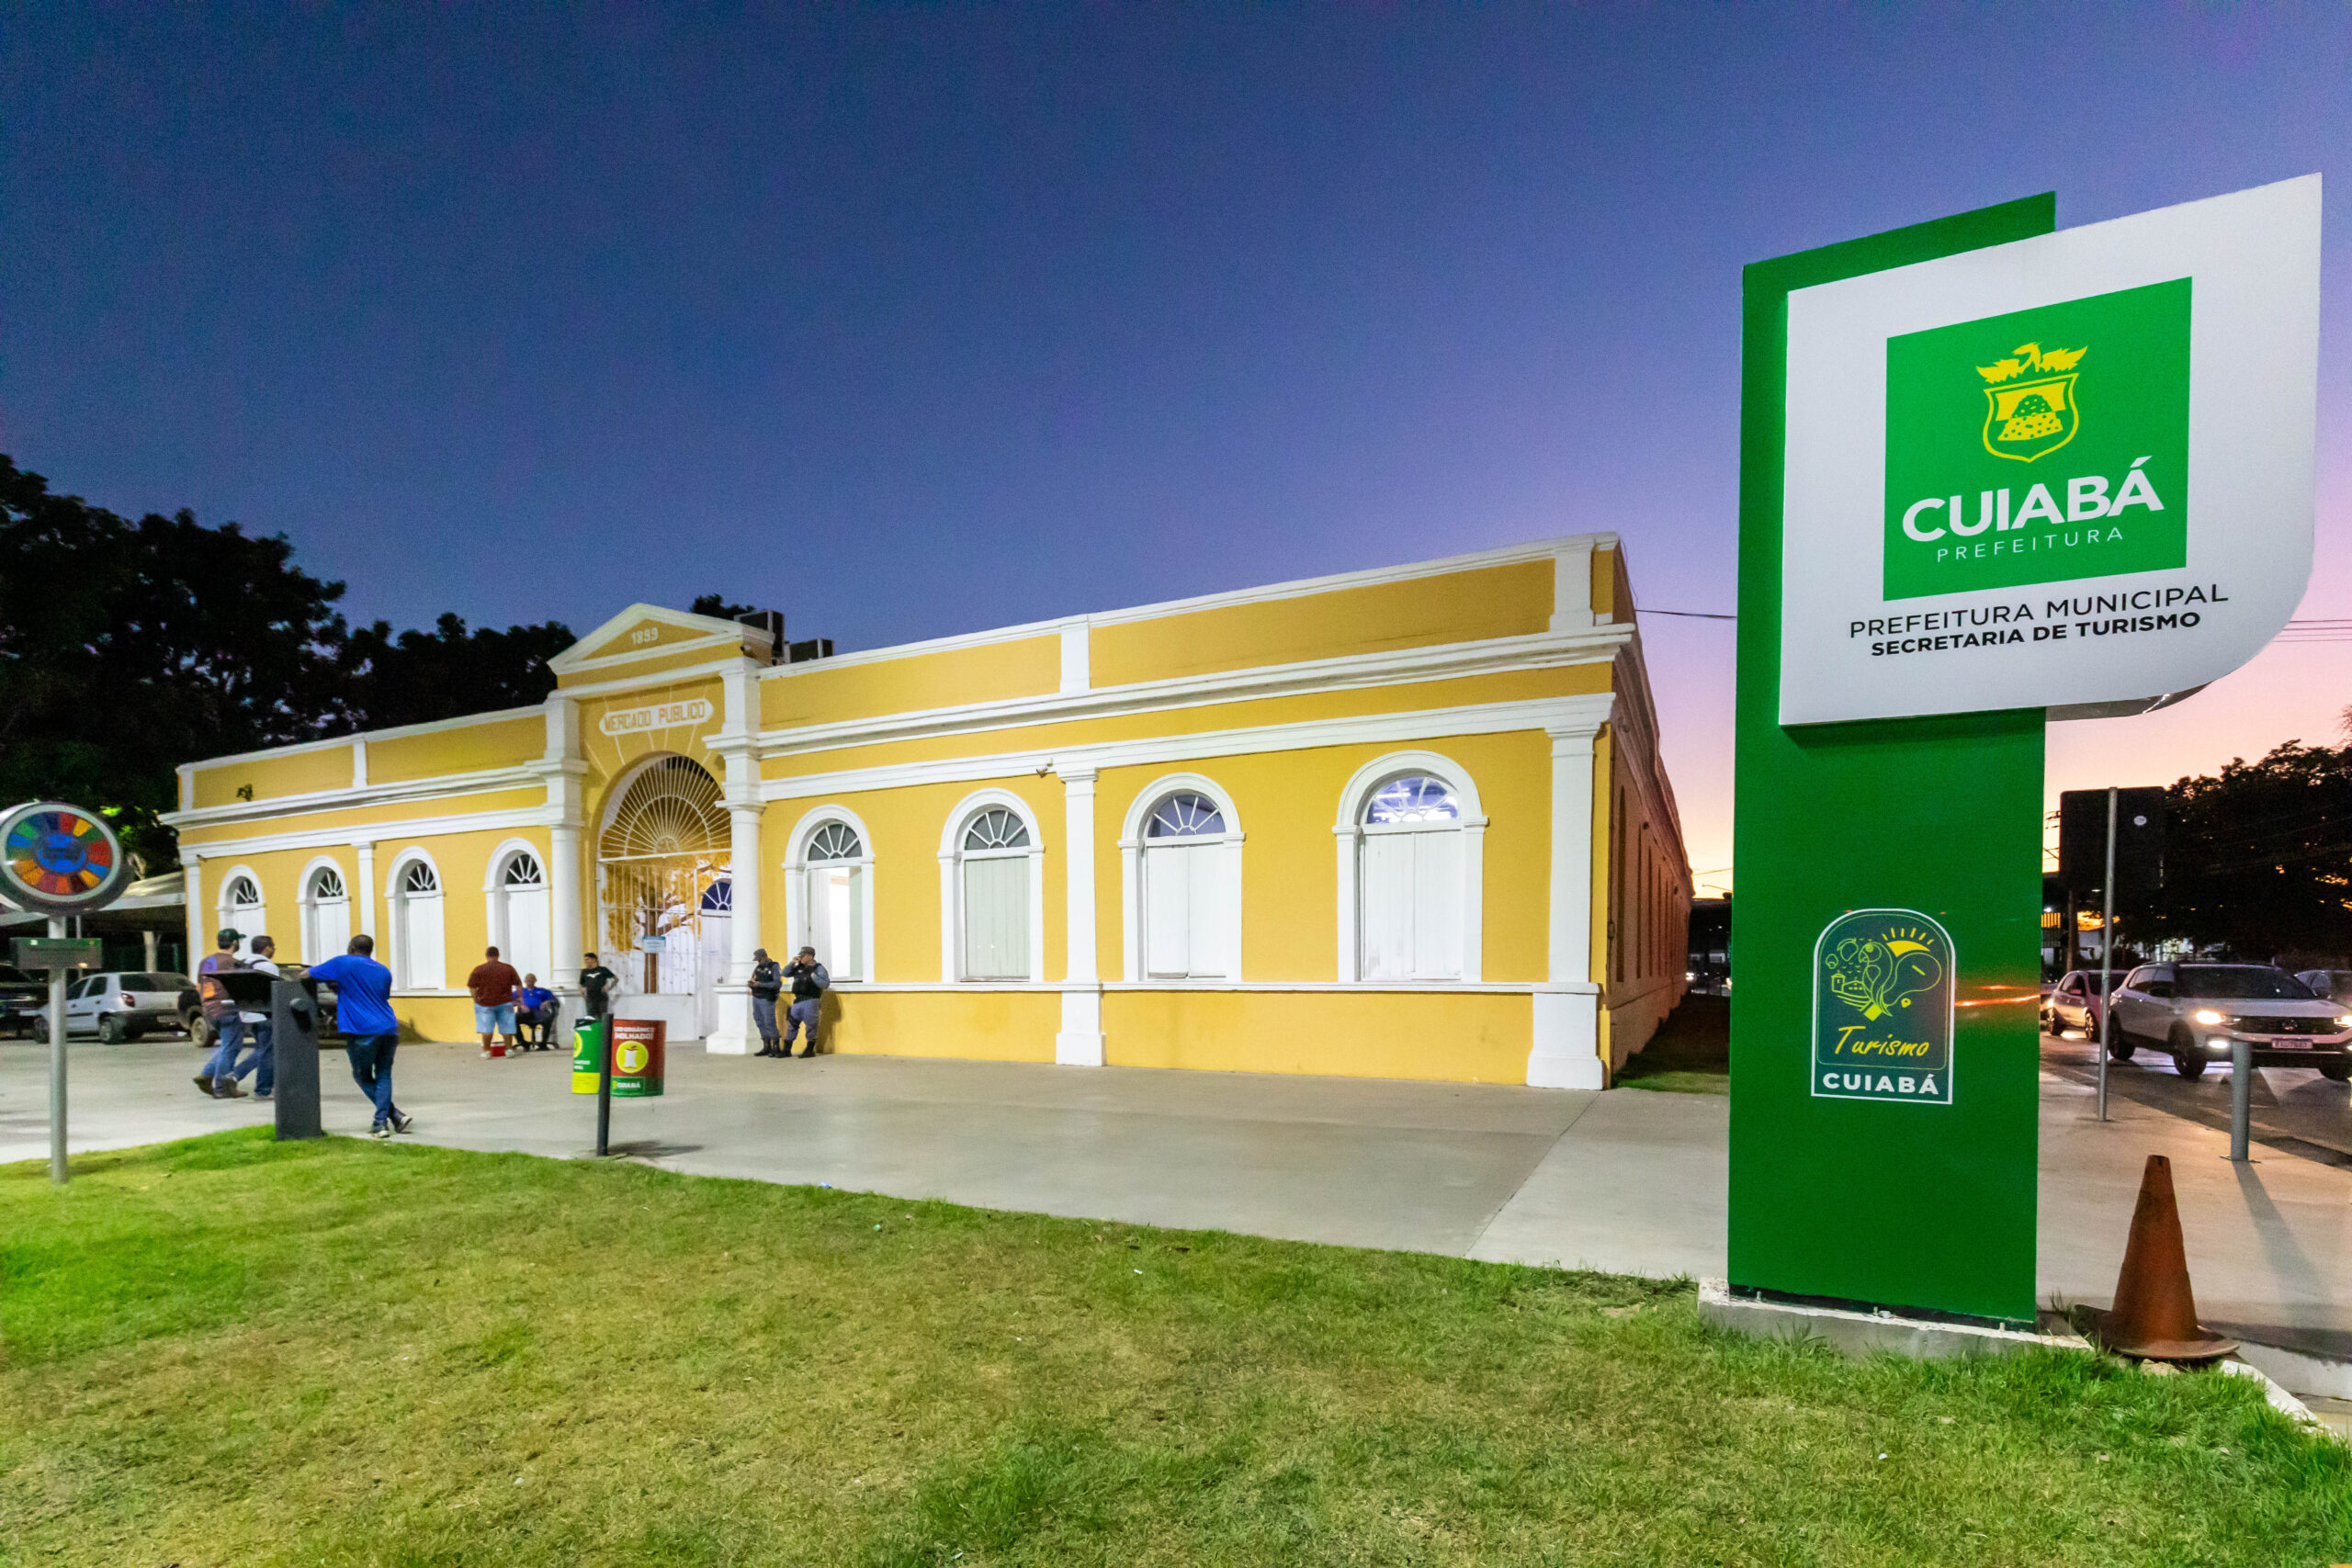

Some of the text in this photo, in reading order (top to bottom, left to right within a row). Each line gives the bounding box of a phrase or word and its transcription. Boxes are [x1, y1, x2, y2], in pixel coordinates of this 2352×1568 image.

[1902, 455, 2165, 542] CUIABÁ
[1937, 526, 2123, 563] PREFEITURA
[1850, 584, 2229, 638] PREFEITURA MUNICIPAL
[631, 626, 659, 645] 1899
[1871, 612, 2201, 656] SECRETARIA DE TURISMO
[604, 709, 651, 732] MERCADO
[1835, 1025, 1929, 1056] Turismo
[1822, 1073, 1939, 1095] CUIABÁ
